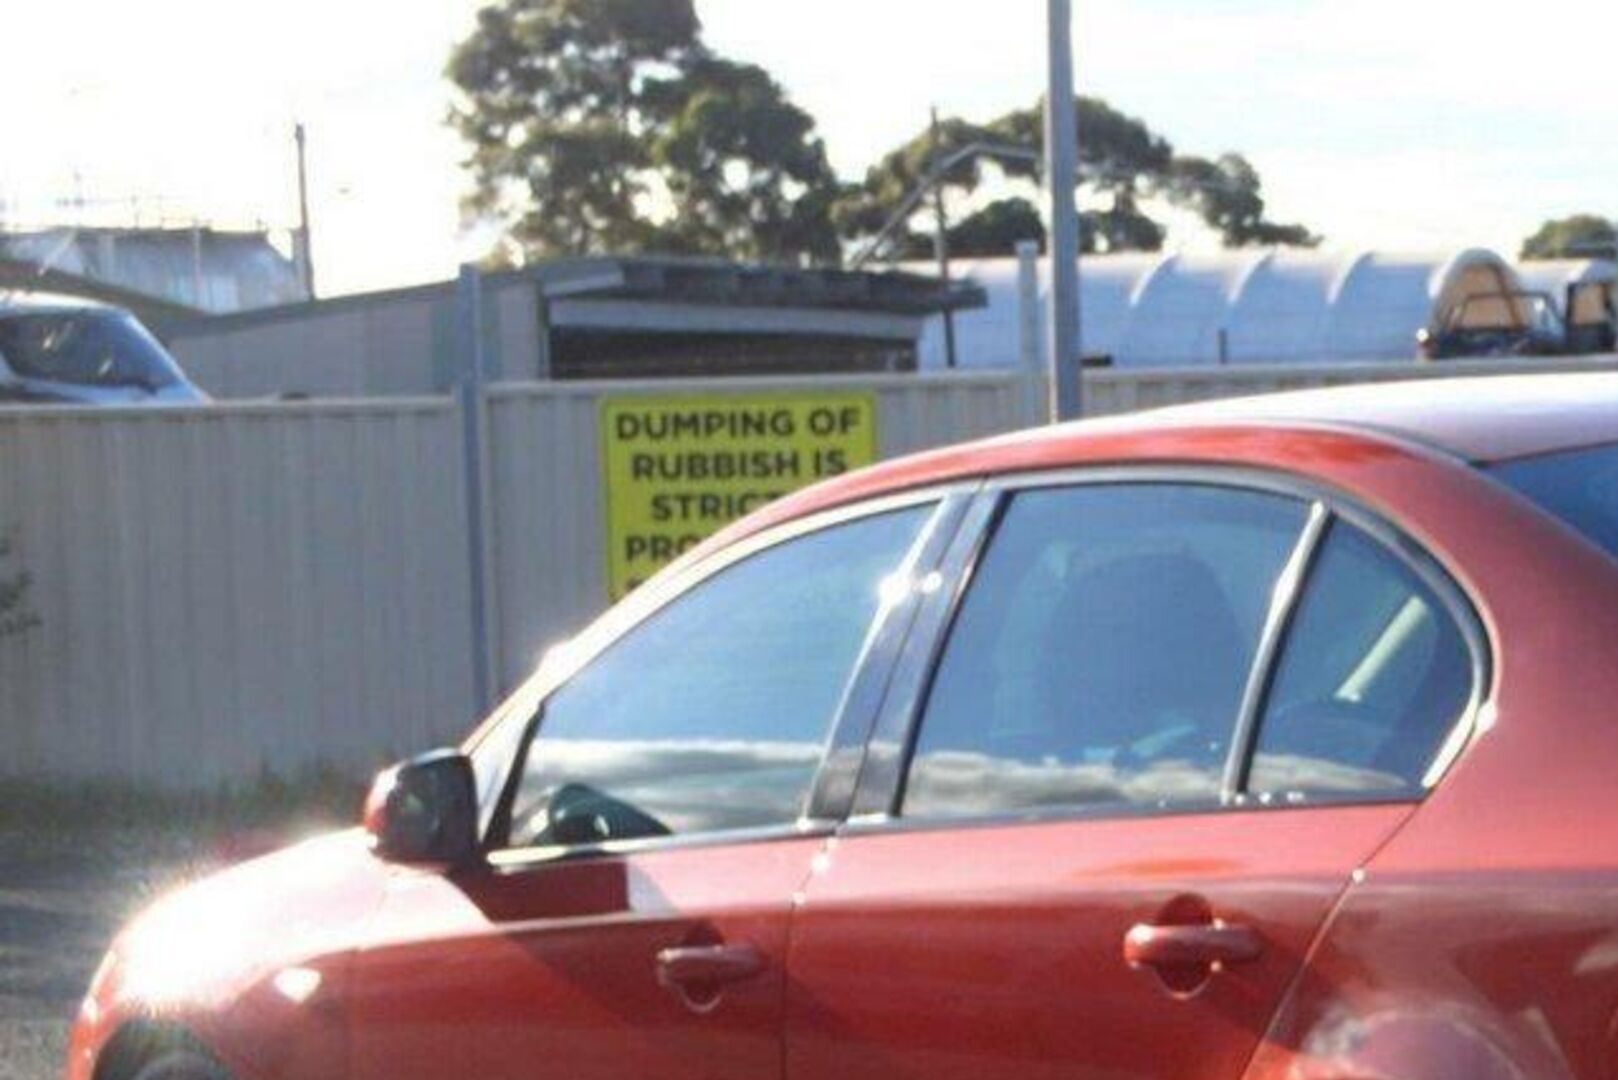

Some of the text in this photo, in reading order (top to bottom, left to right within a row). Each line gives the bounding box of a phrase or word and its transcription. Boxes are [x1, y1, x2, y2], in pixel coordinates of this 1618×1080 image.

[615, 406, 861, 440] DUMPING OF
[631, 447, 848, 481] RUBBISH IS
